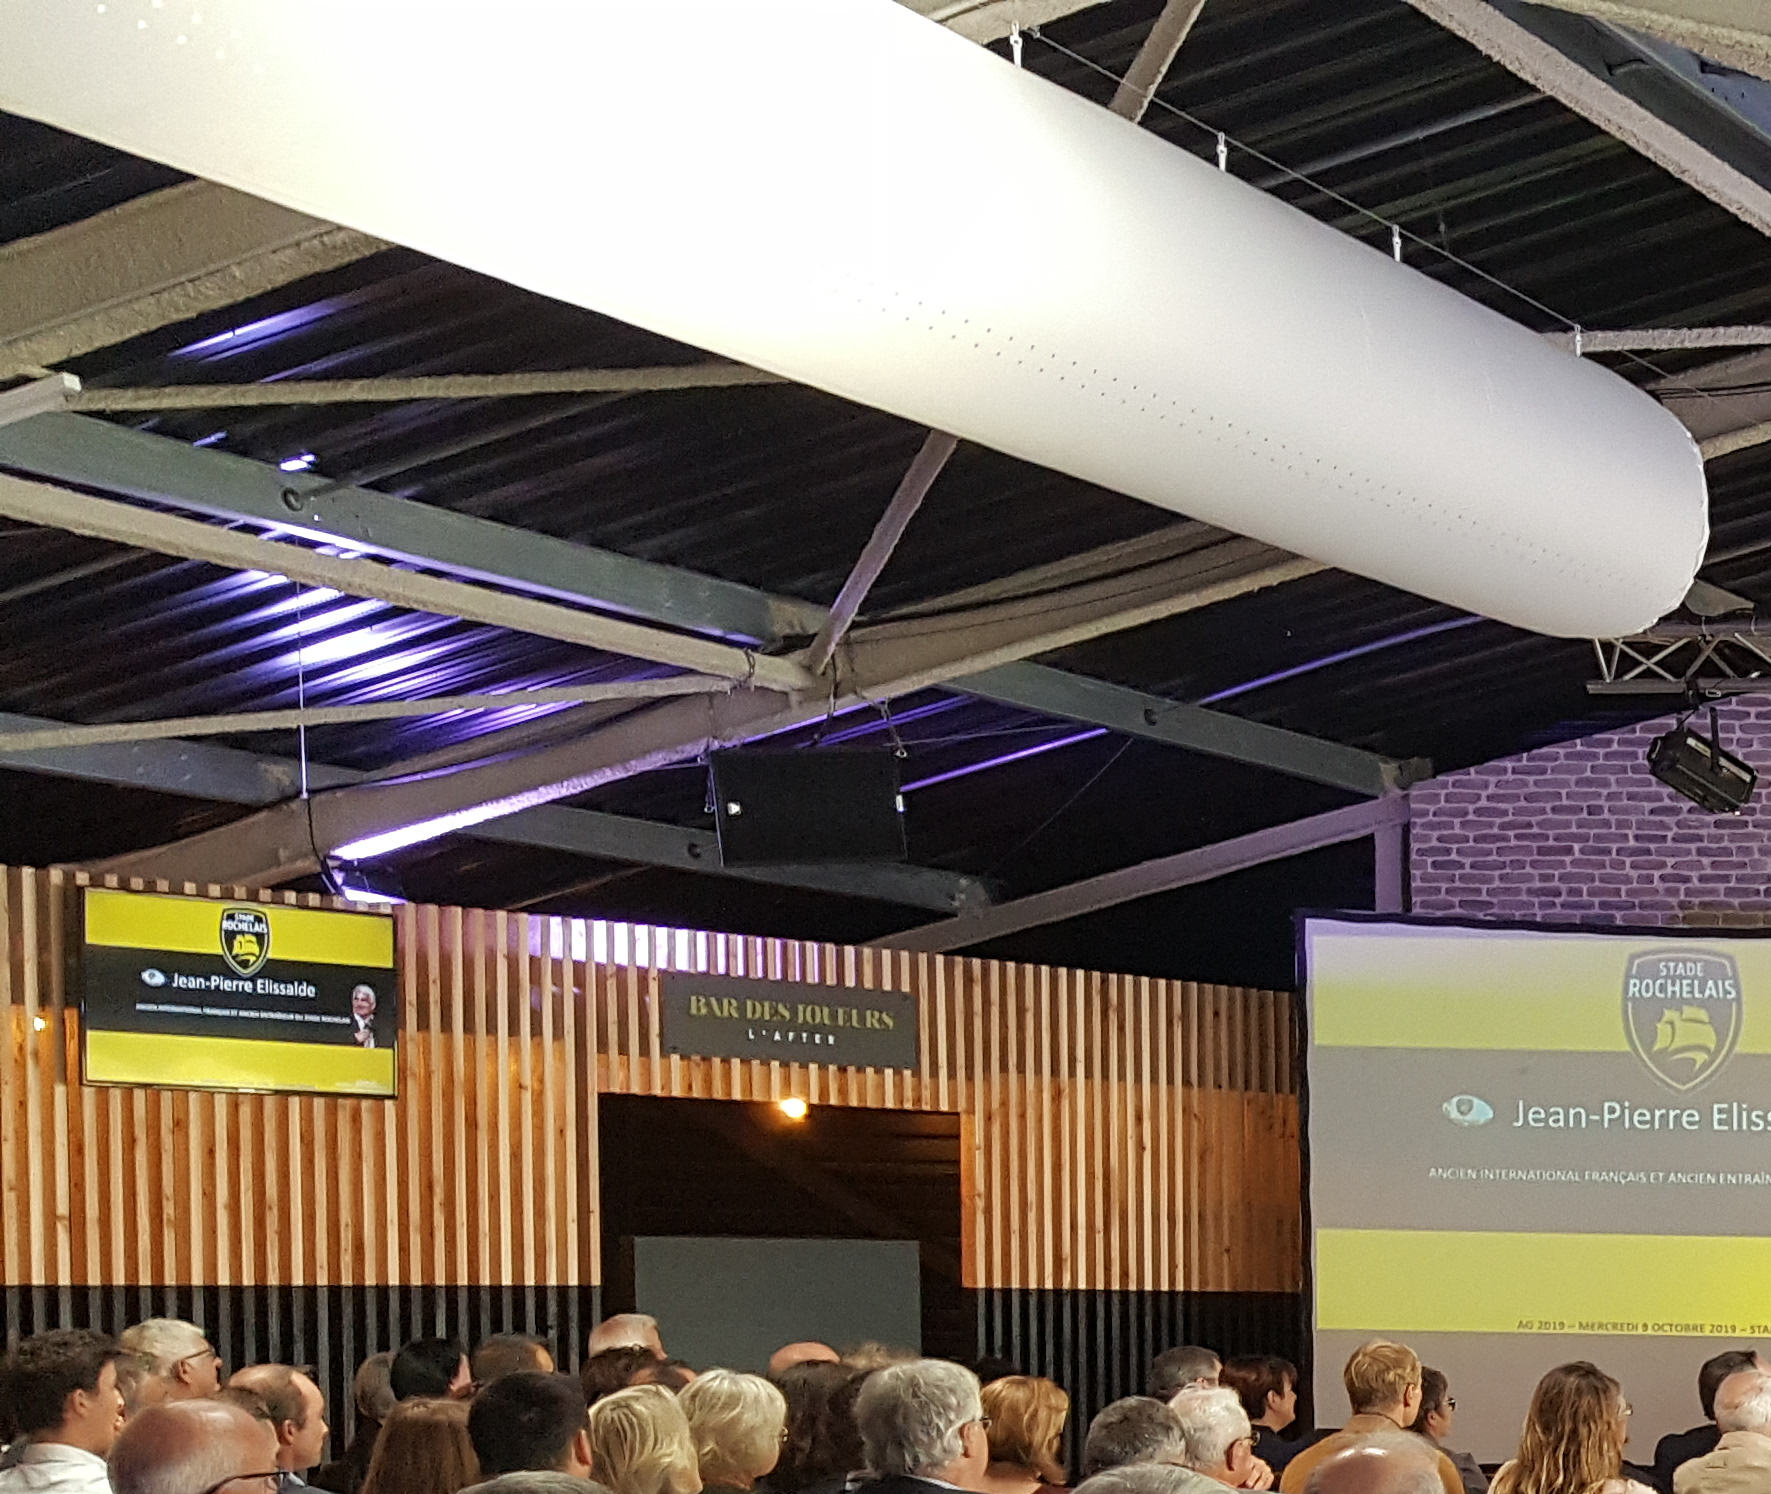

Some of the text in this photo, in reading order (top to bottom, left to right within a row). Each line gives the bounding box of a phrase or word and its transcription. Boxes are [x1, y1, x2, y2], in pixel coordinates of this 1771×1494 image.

[221, 920, 267, 934] ROCHELAIS
[1659, 961, 1705, 976] STADE
[171, 972, 316, 998] Jean-Pierre Elissalde
[1627, 978, 1737, 999] ROCHELAIS
[689, 995, 895, 1030] BAR DES JOUEURS
[748, 1029, 836, 1046] L'AFTER
[1512, 1100, 1700, 1130] Jean-Pierre
[1428, 1167, 1477, 1181] ANCIEN
[1480, 1168, 1581, 1182] INTERNATIONAL
[1584, 1170, 1647, 1185] FRANÇAIS
[1650, 1172, 1665, 1183] ET
[1667, 1172, 1716, 1184] ANCIEN
[1517, 1320, 1533, 1330] AG
[1537, 1320, 1565, 1331] 2019
[1578, 1321, 1638, 1332] MERCREDI
[1641, 1322, 1649, 1332] 9
[1652, 1322, 1705, 1333] OCTOBRE
[1709, 1324, 1737, 1334] 2019
